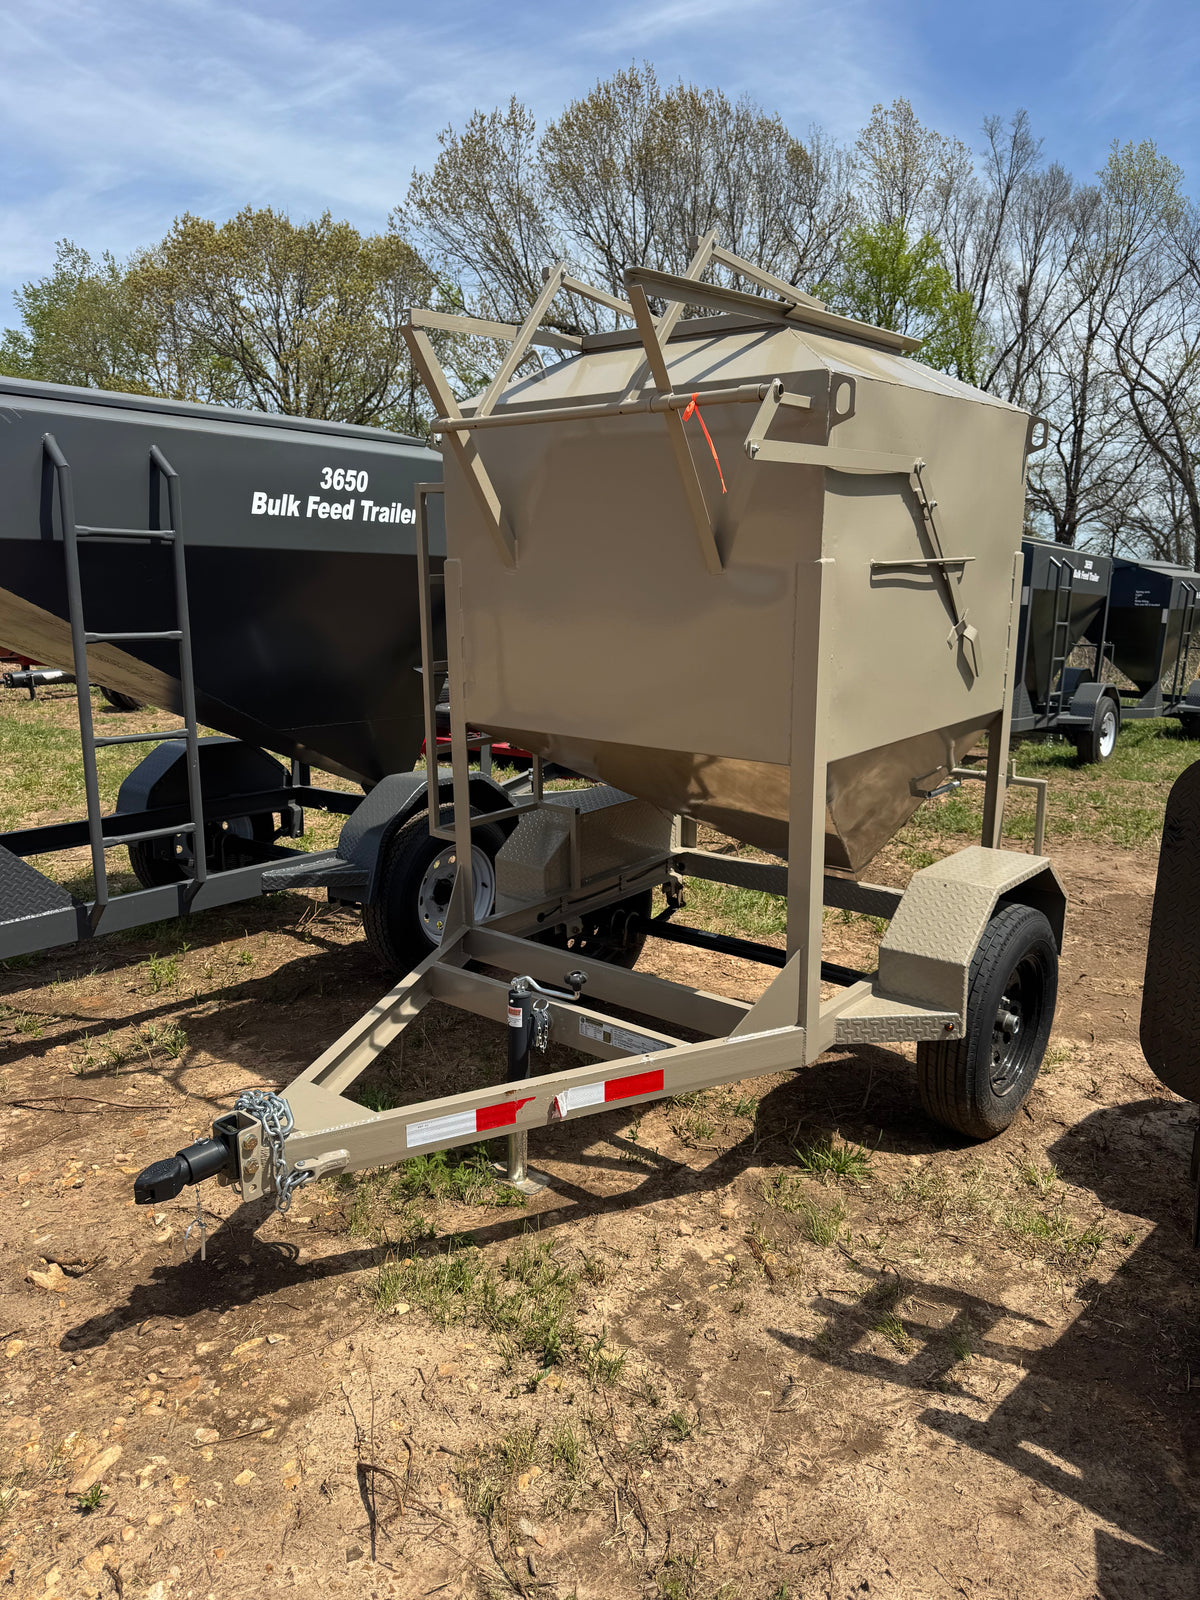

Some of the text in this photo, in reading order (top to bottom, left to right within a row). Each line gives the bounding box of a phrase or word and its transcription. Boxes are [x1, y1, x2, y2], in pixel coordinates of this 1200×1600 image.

[320, 467, 369, 493] 3650
[251, 491, 301, 517] Bulk
[306, 495, 356, 521] Feed
